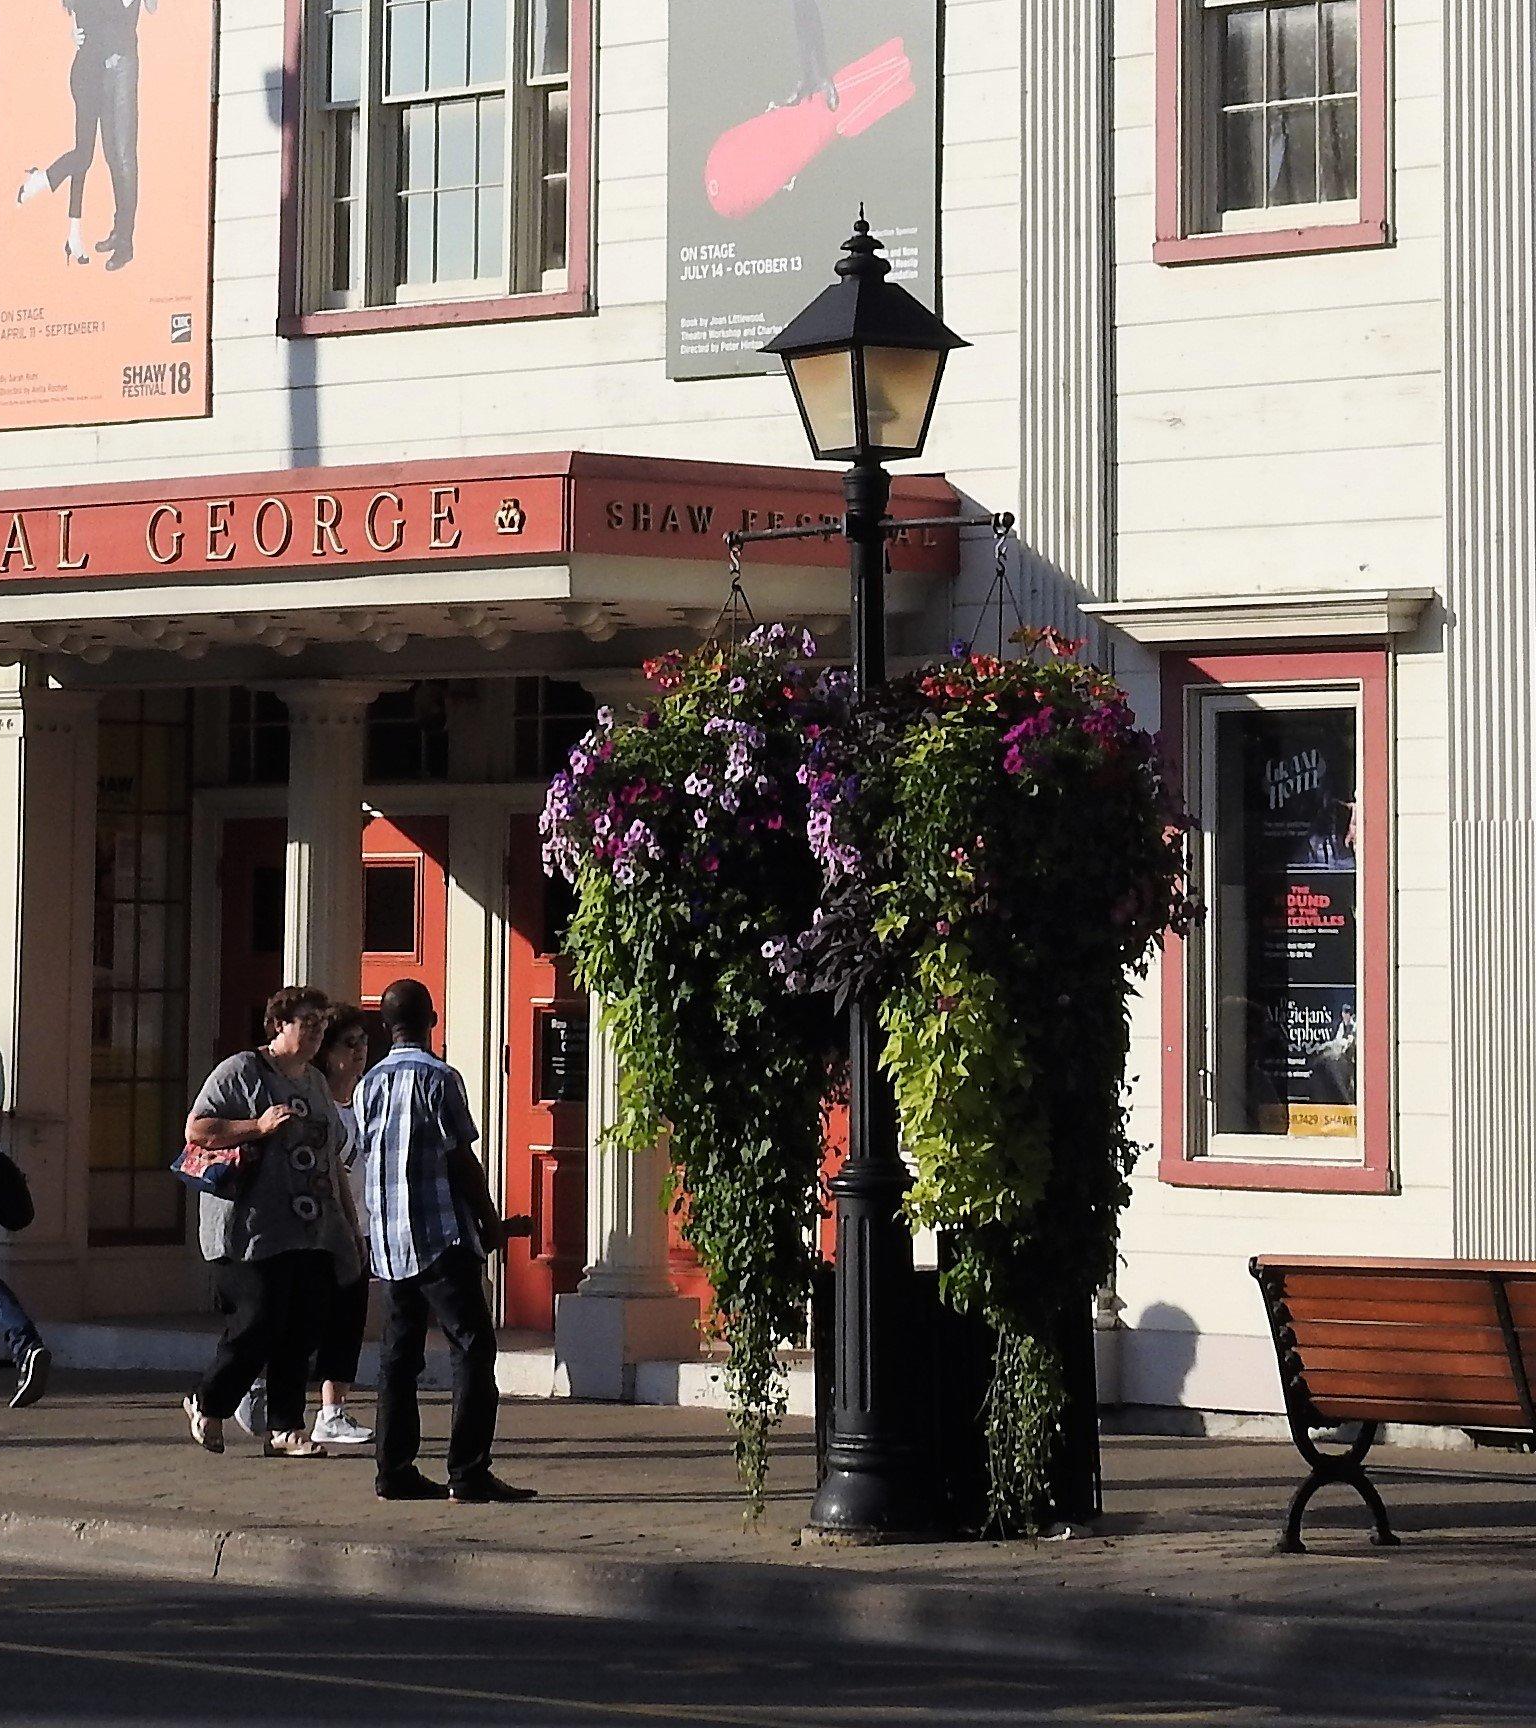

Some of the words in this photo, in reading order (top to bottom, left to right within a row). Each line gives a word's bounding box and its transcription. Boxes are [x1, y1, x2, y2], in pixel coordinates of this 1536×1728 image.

[680, 247, 698, 262] ON
[700, 242, 736, 260] STAGE
[680, 264, 710, 281] JULY
[711, 263, 724, 278] 14
[734, 257, 789, 276] OCTOBER
[789, 255, 803, 271] 13
[0, 310, 14, 323] ON
[16, 307, 45, 322] STAGE
[0, 327, 27, 340] APRIL
[45, 321, 99, 338] SEPTEMBER
[122, 363, 166, 385] SHAW
[169, 361, 191, 395] 18
[122, 381, 166, 398] FESTIVAL
[145, 486, 463, 565] GEORGE
[605, 500, 716, 535] SHAW
[740, 507, 938, 549] FESTAL
